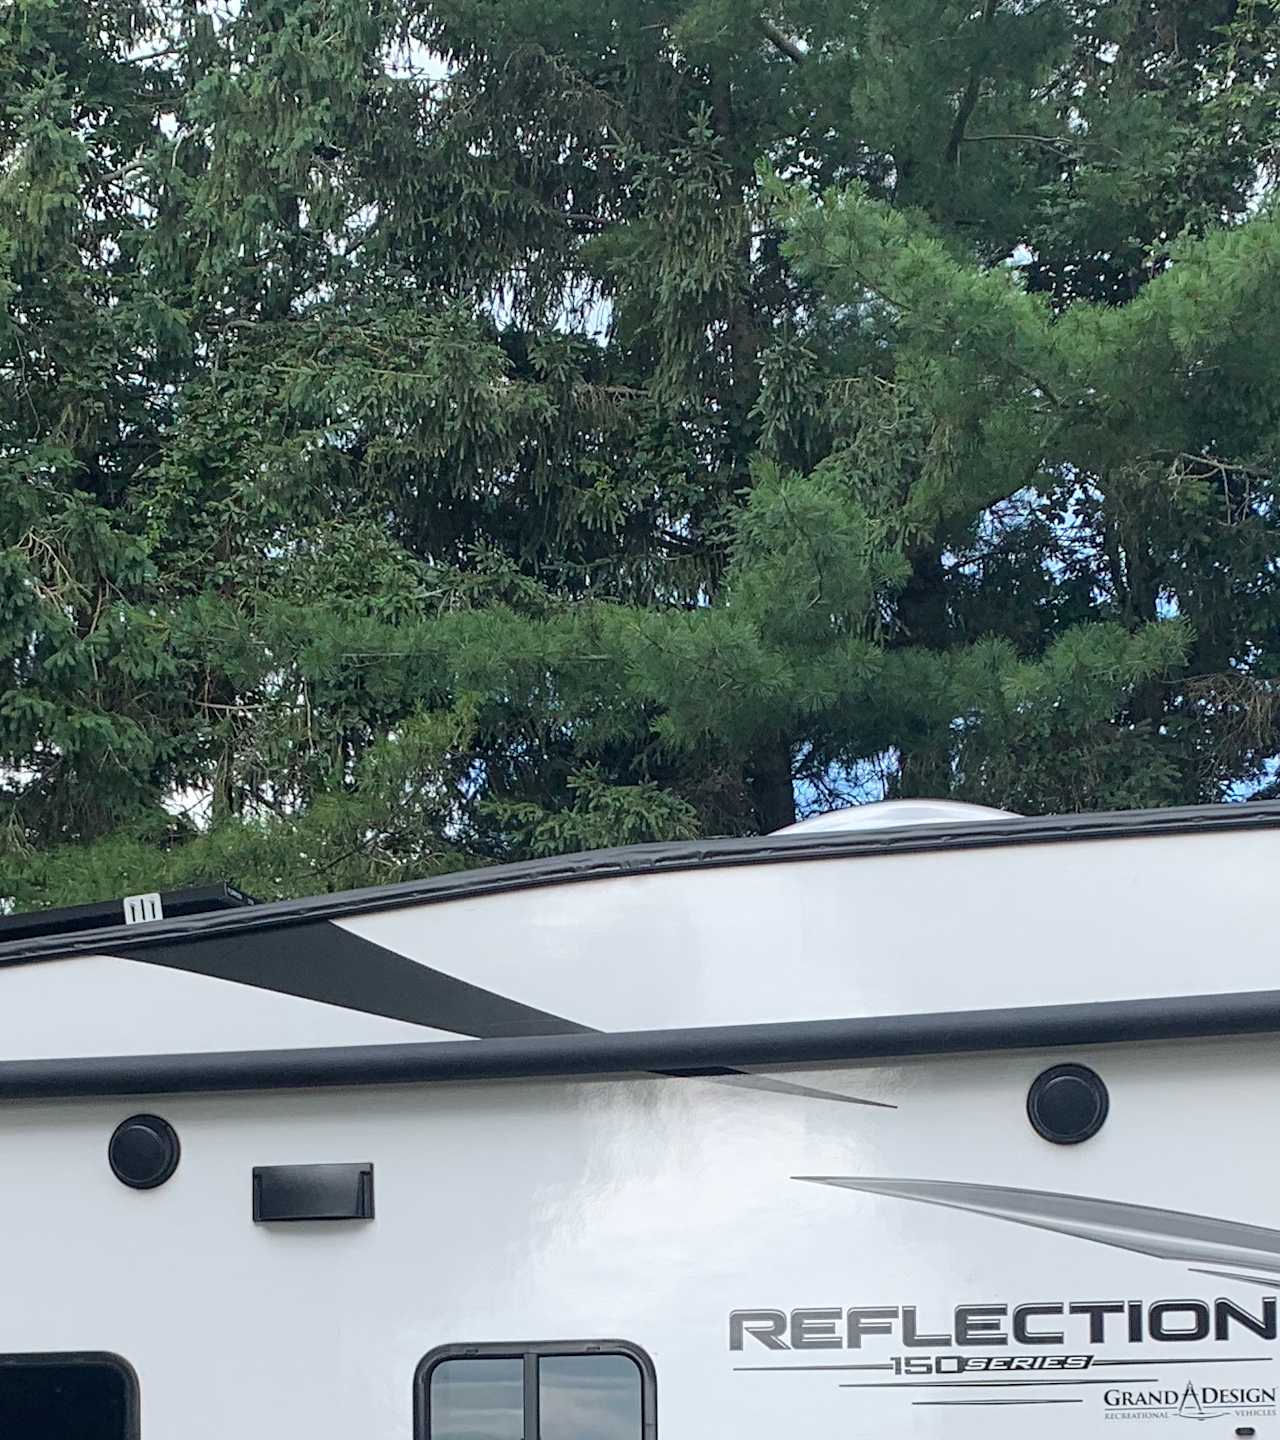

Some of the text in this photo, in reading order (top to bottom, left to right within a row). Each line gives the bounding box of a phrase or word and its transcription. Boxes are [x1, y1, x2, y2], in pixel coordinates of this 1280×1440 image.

[729, 1296, 1277, 1351] REFLECTION
[889, 1355, 1089, 1376] 150 SERIES
[1104, 1386, 1276, 1406] GRAND DESIGN
[1104, 1409, 1277, 1420] RECREATIONAL VEHICLES
